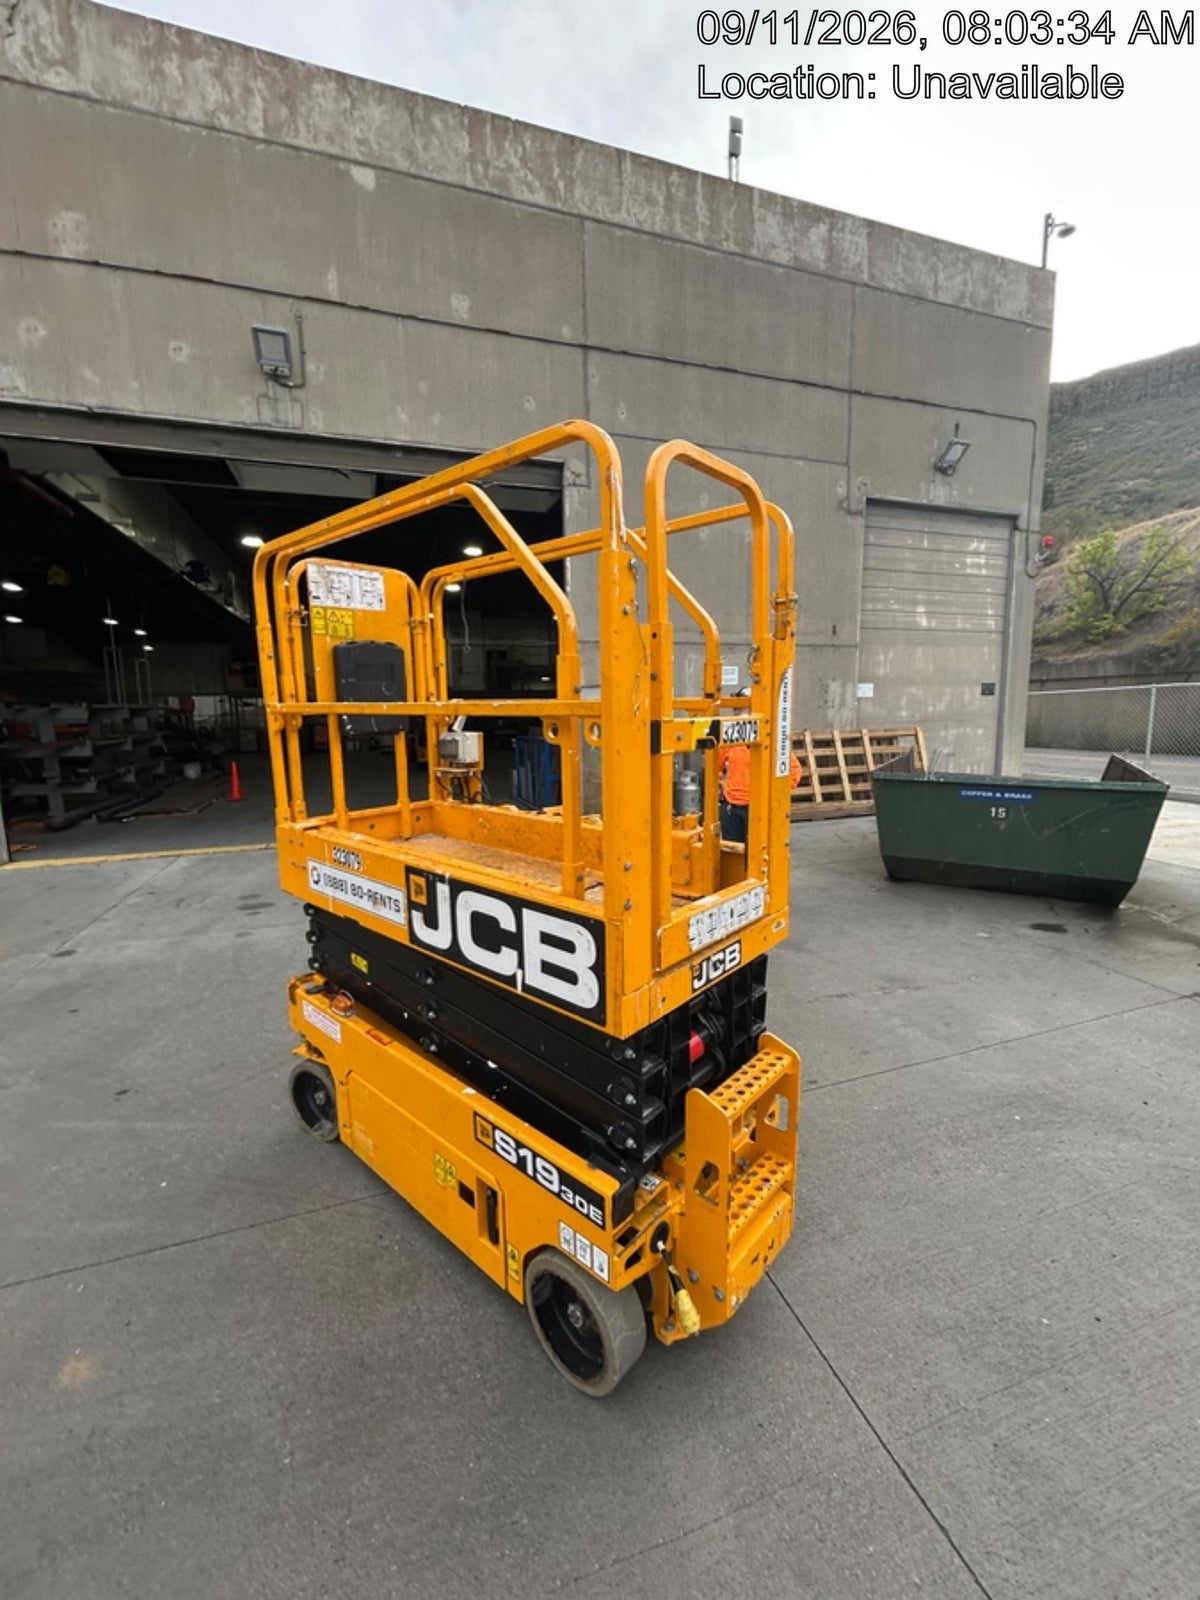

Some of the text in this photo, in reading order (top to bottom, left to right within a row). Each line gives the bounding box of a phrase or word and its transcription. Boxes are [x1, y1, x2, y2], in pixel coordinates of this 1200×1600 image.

[722, 720, 758, 744] 323079
[990, 806, 1007, 819] 15
[350, 882, 401, 913] 80-RENTS
[411, 881, 600, 1009] JCB
[693, 942, 741, 990] JCB
